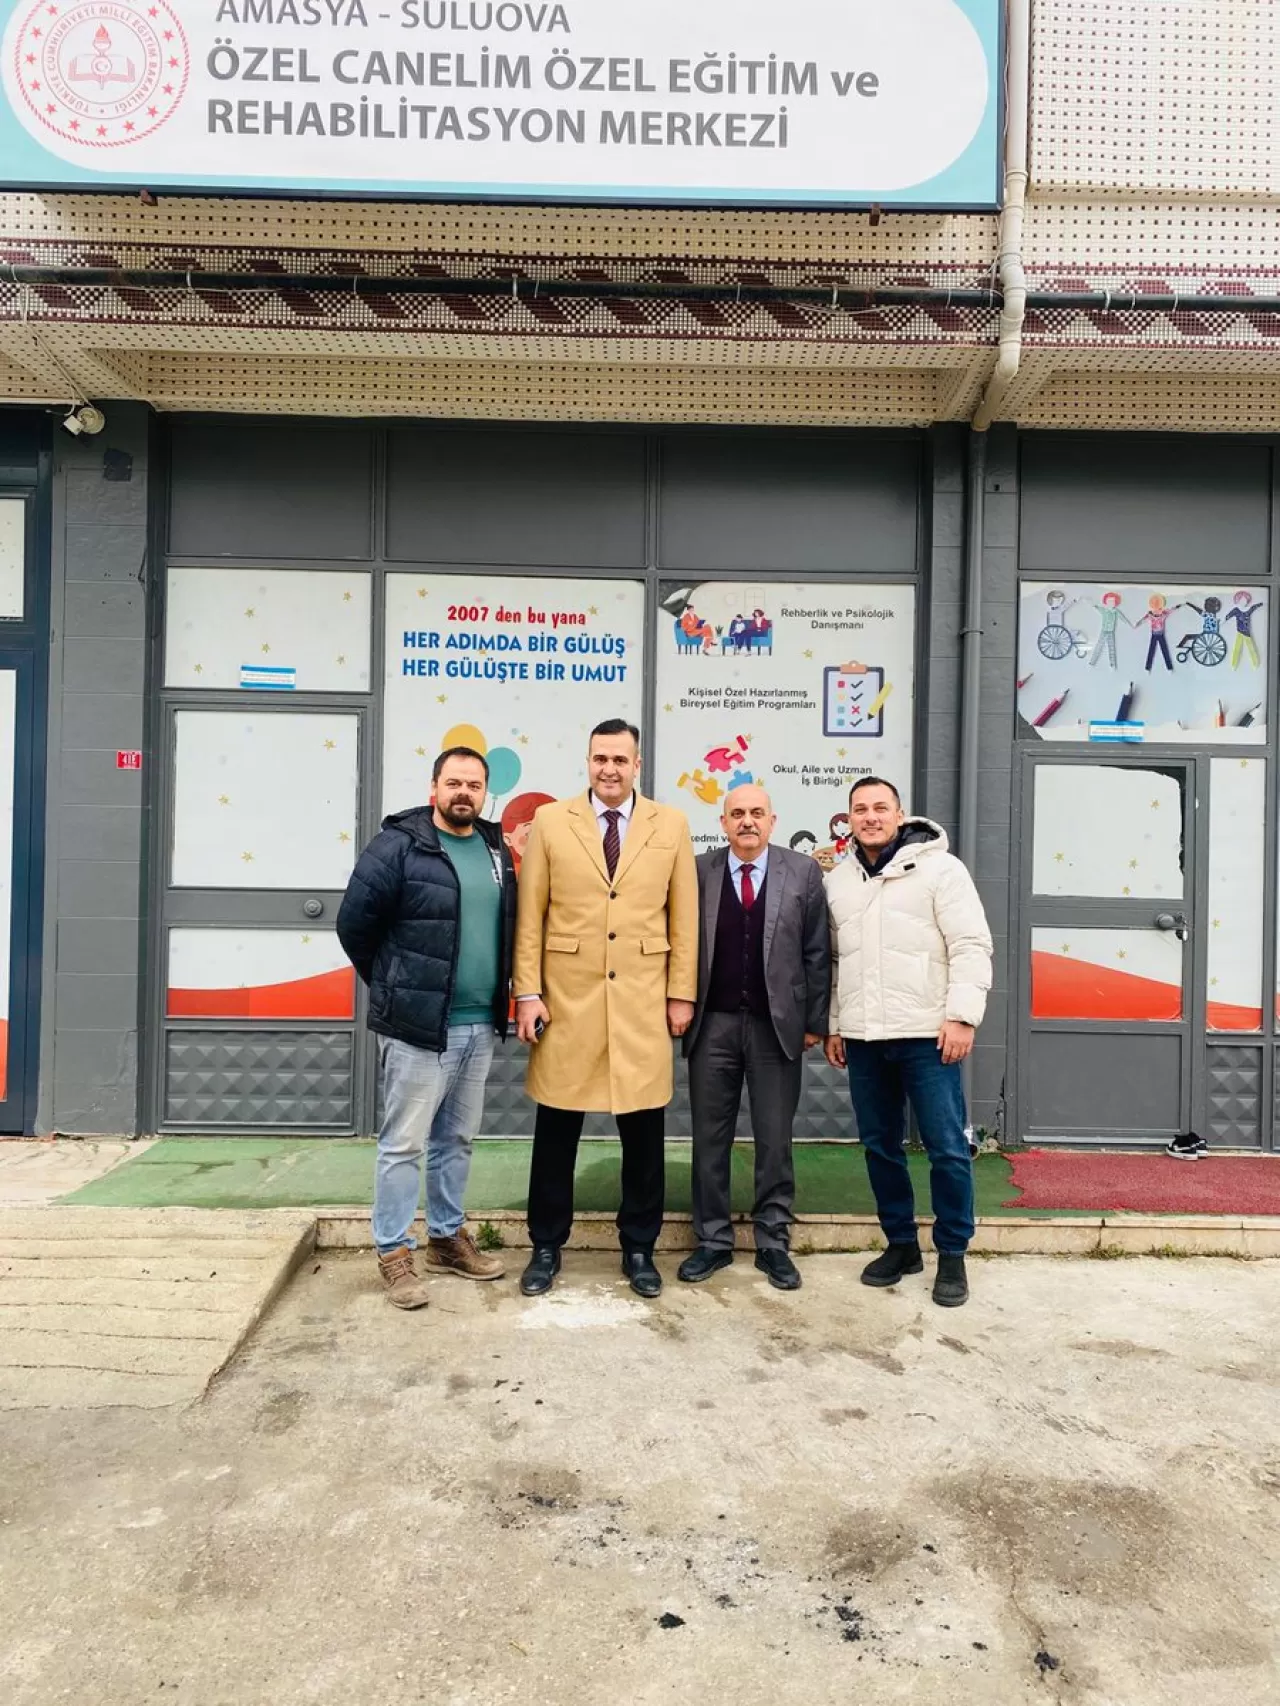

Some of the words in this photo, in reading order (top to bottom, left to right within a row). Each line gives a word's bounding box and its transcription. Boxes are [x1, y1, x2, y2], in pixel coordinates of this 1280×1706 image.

[216, 0, 367, 27] AMASYA
[402, 0, 571, 33] SULUOVA
[207, 38, 320, 82] ÖZEL
[333, 45, 531, 89] CANELİM
[544, 48, 656, 92] ÖZEL
[669, 52, 818, 96] EĞİTİM
[831, 71, 879, 98] ve
[208, 95, 585, 144] REHABİLİTASYON
[599, 106, 788, 148] MERKEZİ
[448, 605, 489, 621] 2007
[495, 606, 521, 623] den
[528, 607, 546, 624] bu
[552, 610, 587, 629] yana
[780, 608, 829, 618] Rehberlik
[845, 609, 895, 620] Psikolojik
[811, 620, 864, 631] Danışmanı
[403, 631, 440, 649] HER
[445, 634, 522, 652] ADIMDA
[528, 632, 558, 652] BİR
[564, 633, 625, 658] GÜLÜŞ
[402, 659, 440, 677] HER
[445, 657, 529, 683] GÜLÜŞTE
[535, 660, 565, 681] BİR
[571, 664, 627, 682] UMUT
[687, 687, 722, 698] Kişisel
[724, 686, 748, 697] Özel
[749, 688, 808, 699] Hazırlanmış
[680, 699, 721, 710] Bireysel
[723, 699, 755, 710] Eğitim
[757, 700, 816, 711] Programları
[801, 765, 821, 774] Aile
[837, 765, 873, 775] Uzman
[801, 775, 811, 786] İş
[813, 776, 843, 787] Birliği
